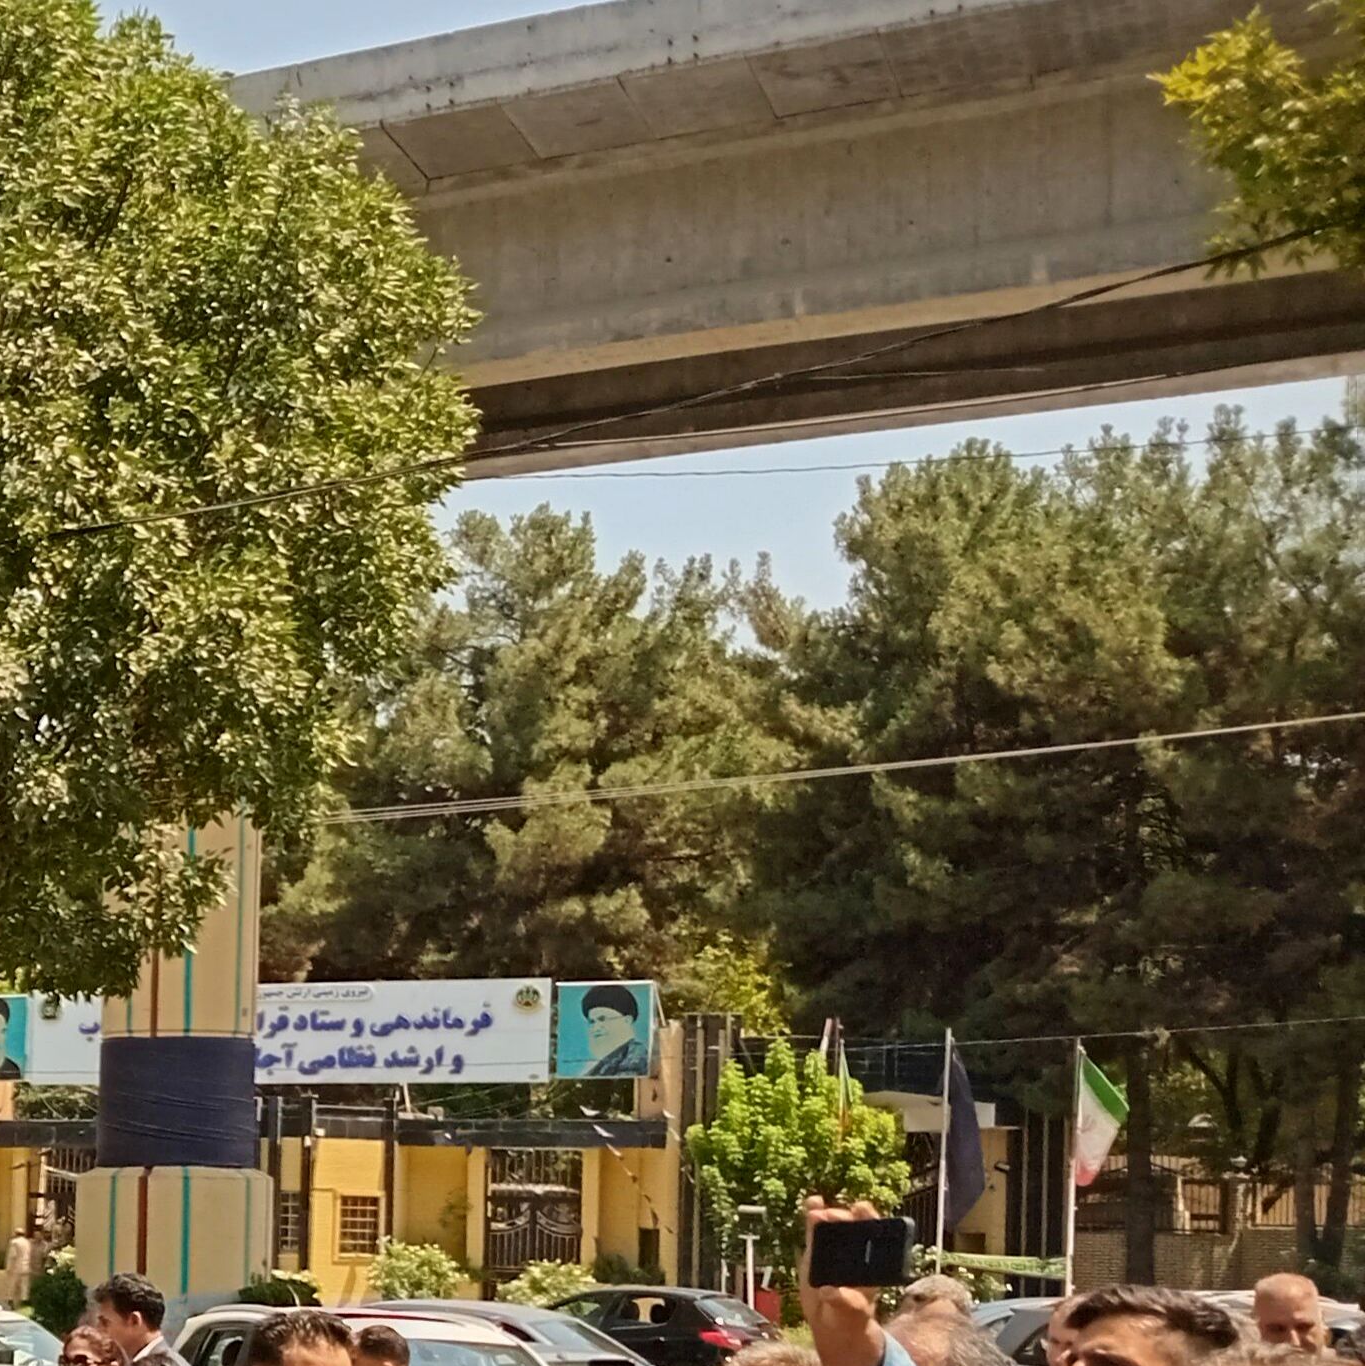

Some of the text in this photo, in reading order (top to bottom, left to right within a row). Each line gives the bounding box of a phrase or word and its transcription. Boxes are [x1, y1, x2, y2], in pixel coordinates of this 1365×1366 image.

[292, 1009, 346, 1032] ستاد
[369, 1002, 494, 1037] فرماندهی
[297, 1045, 377, 1076] نظامی
[382, 1045, 445, 1075] ارشد
